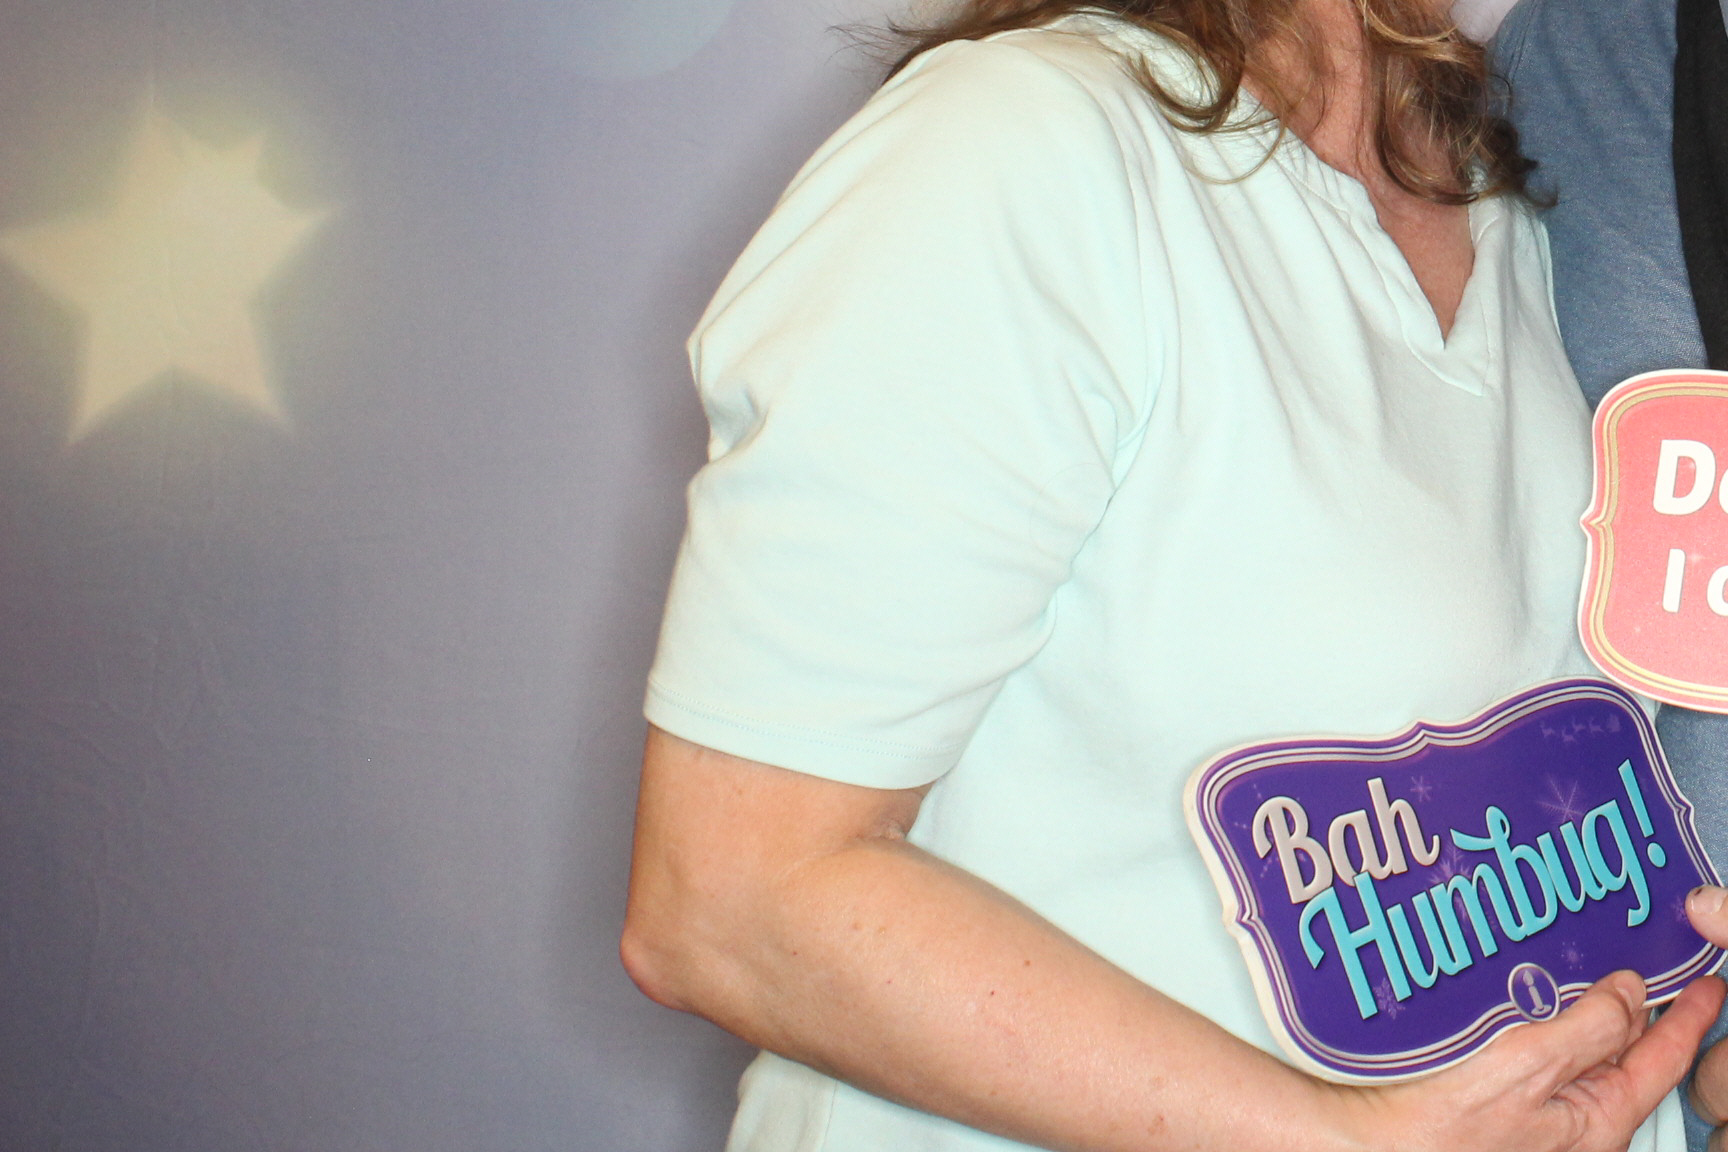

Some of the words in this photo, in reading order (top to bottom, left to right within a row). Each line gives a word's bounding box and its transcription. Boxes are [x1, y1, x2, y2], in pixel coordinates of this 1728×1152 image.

[1662, 548, 1686, 614] I
[1252, 777, 1440, 904] Bah
[1299, 759, 1667, 1020] Humbug!
